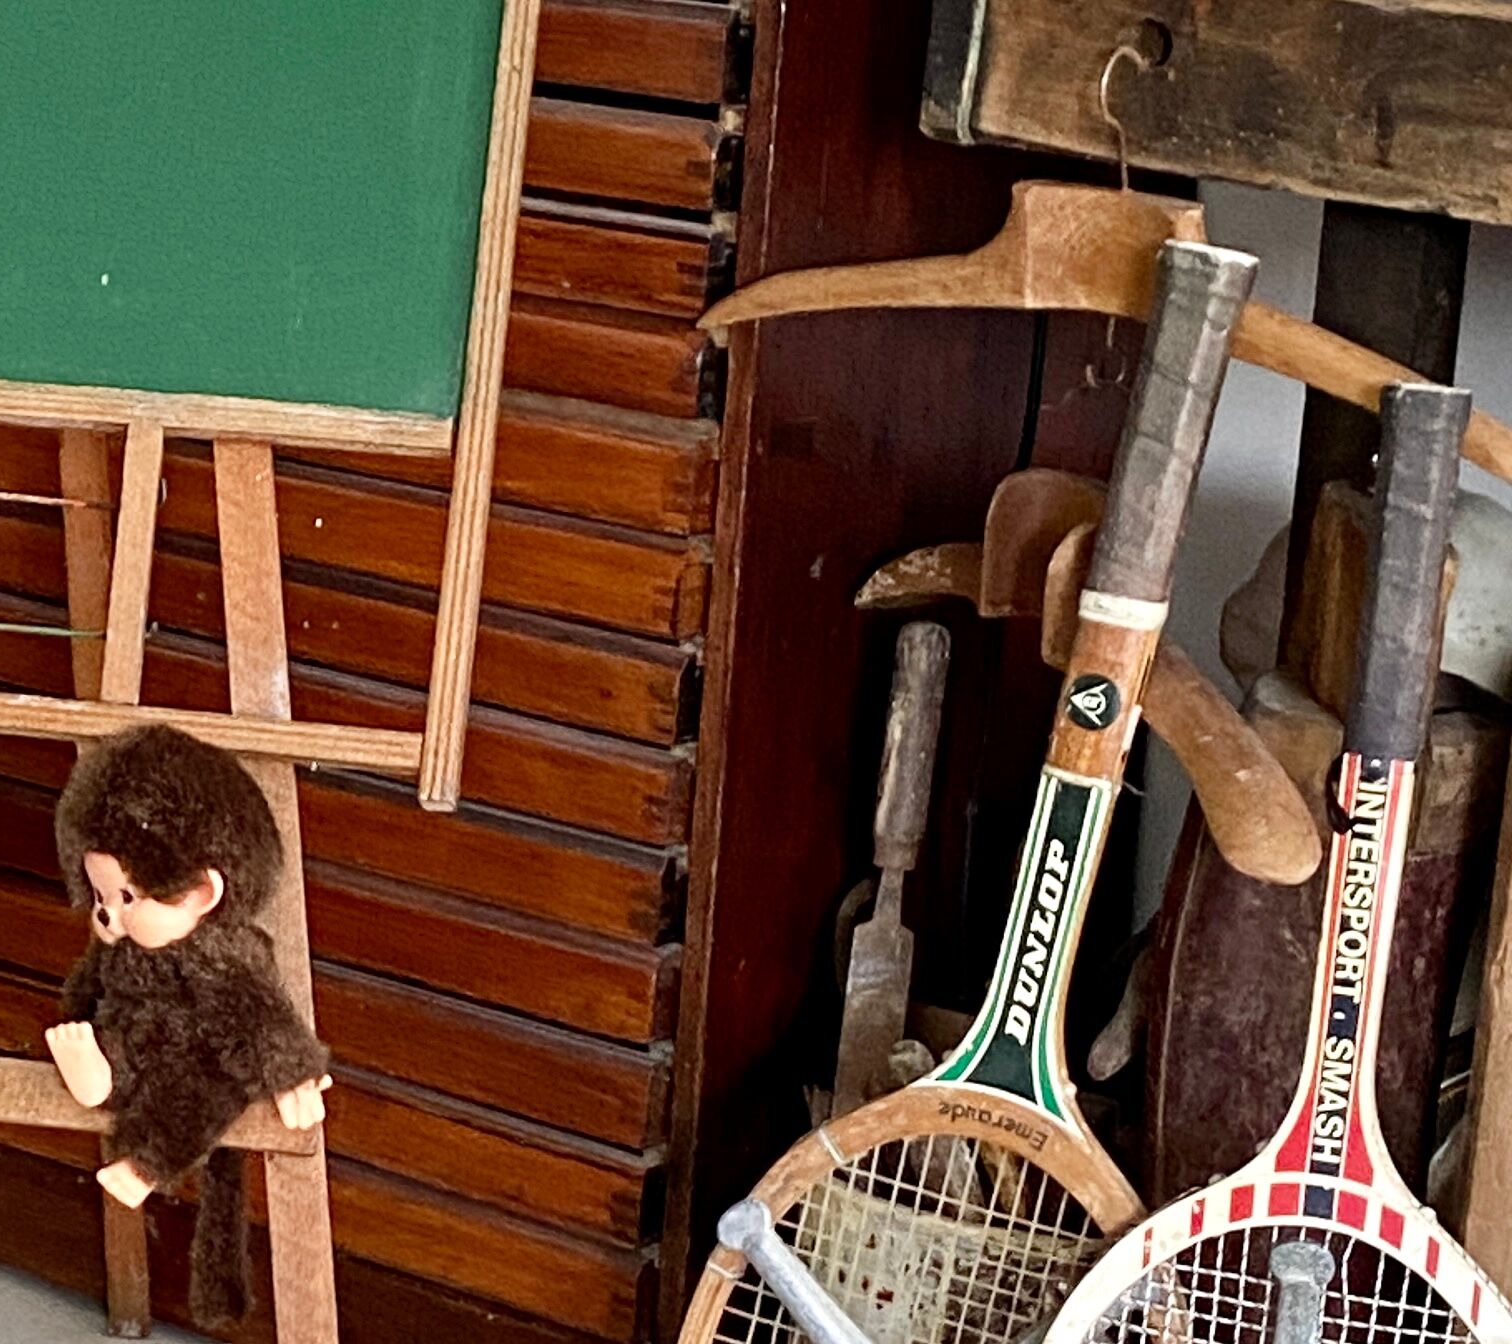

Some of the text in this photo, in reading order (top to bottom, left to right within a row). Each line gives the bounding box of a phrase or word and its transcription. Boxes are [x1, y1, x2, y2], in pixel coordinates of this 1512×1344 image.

[1003, 837, 1070, 1047] DUNLOP
[1311, 778, 1389, 1164] INTERSPORT SMASH
[938, 1099, 1050, 1153] Emeraude
